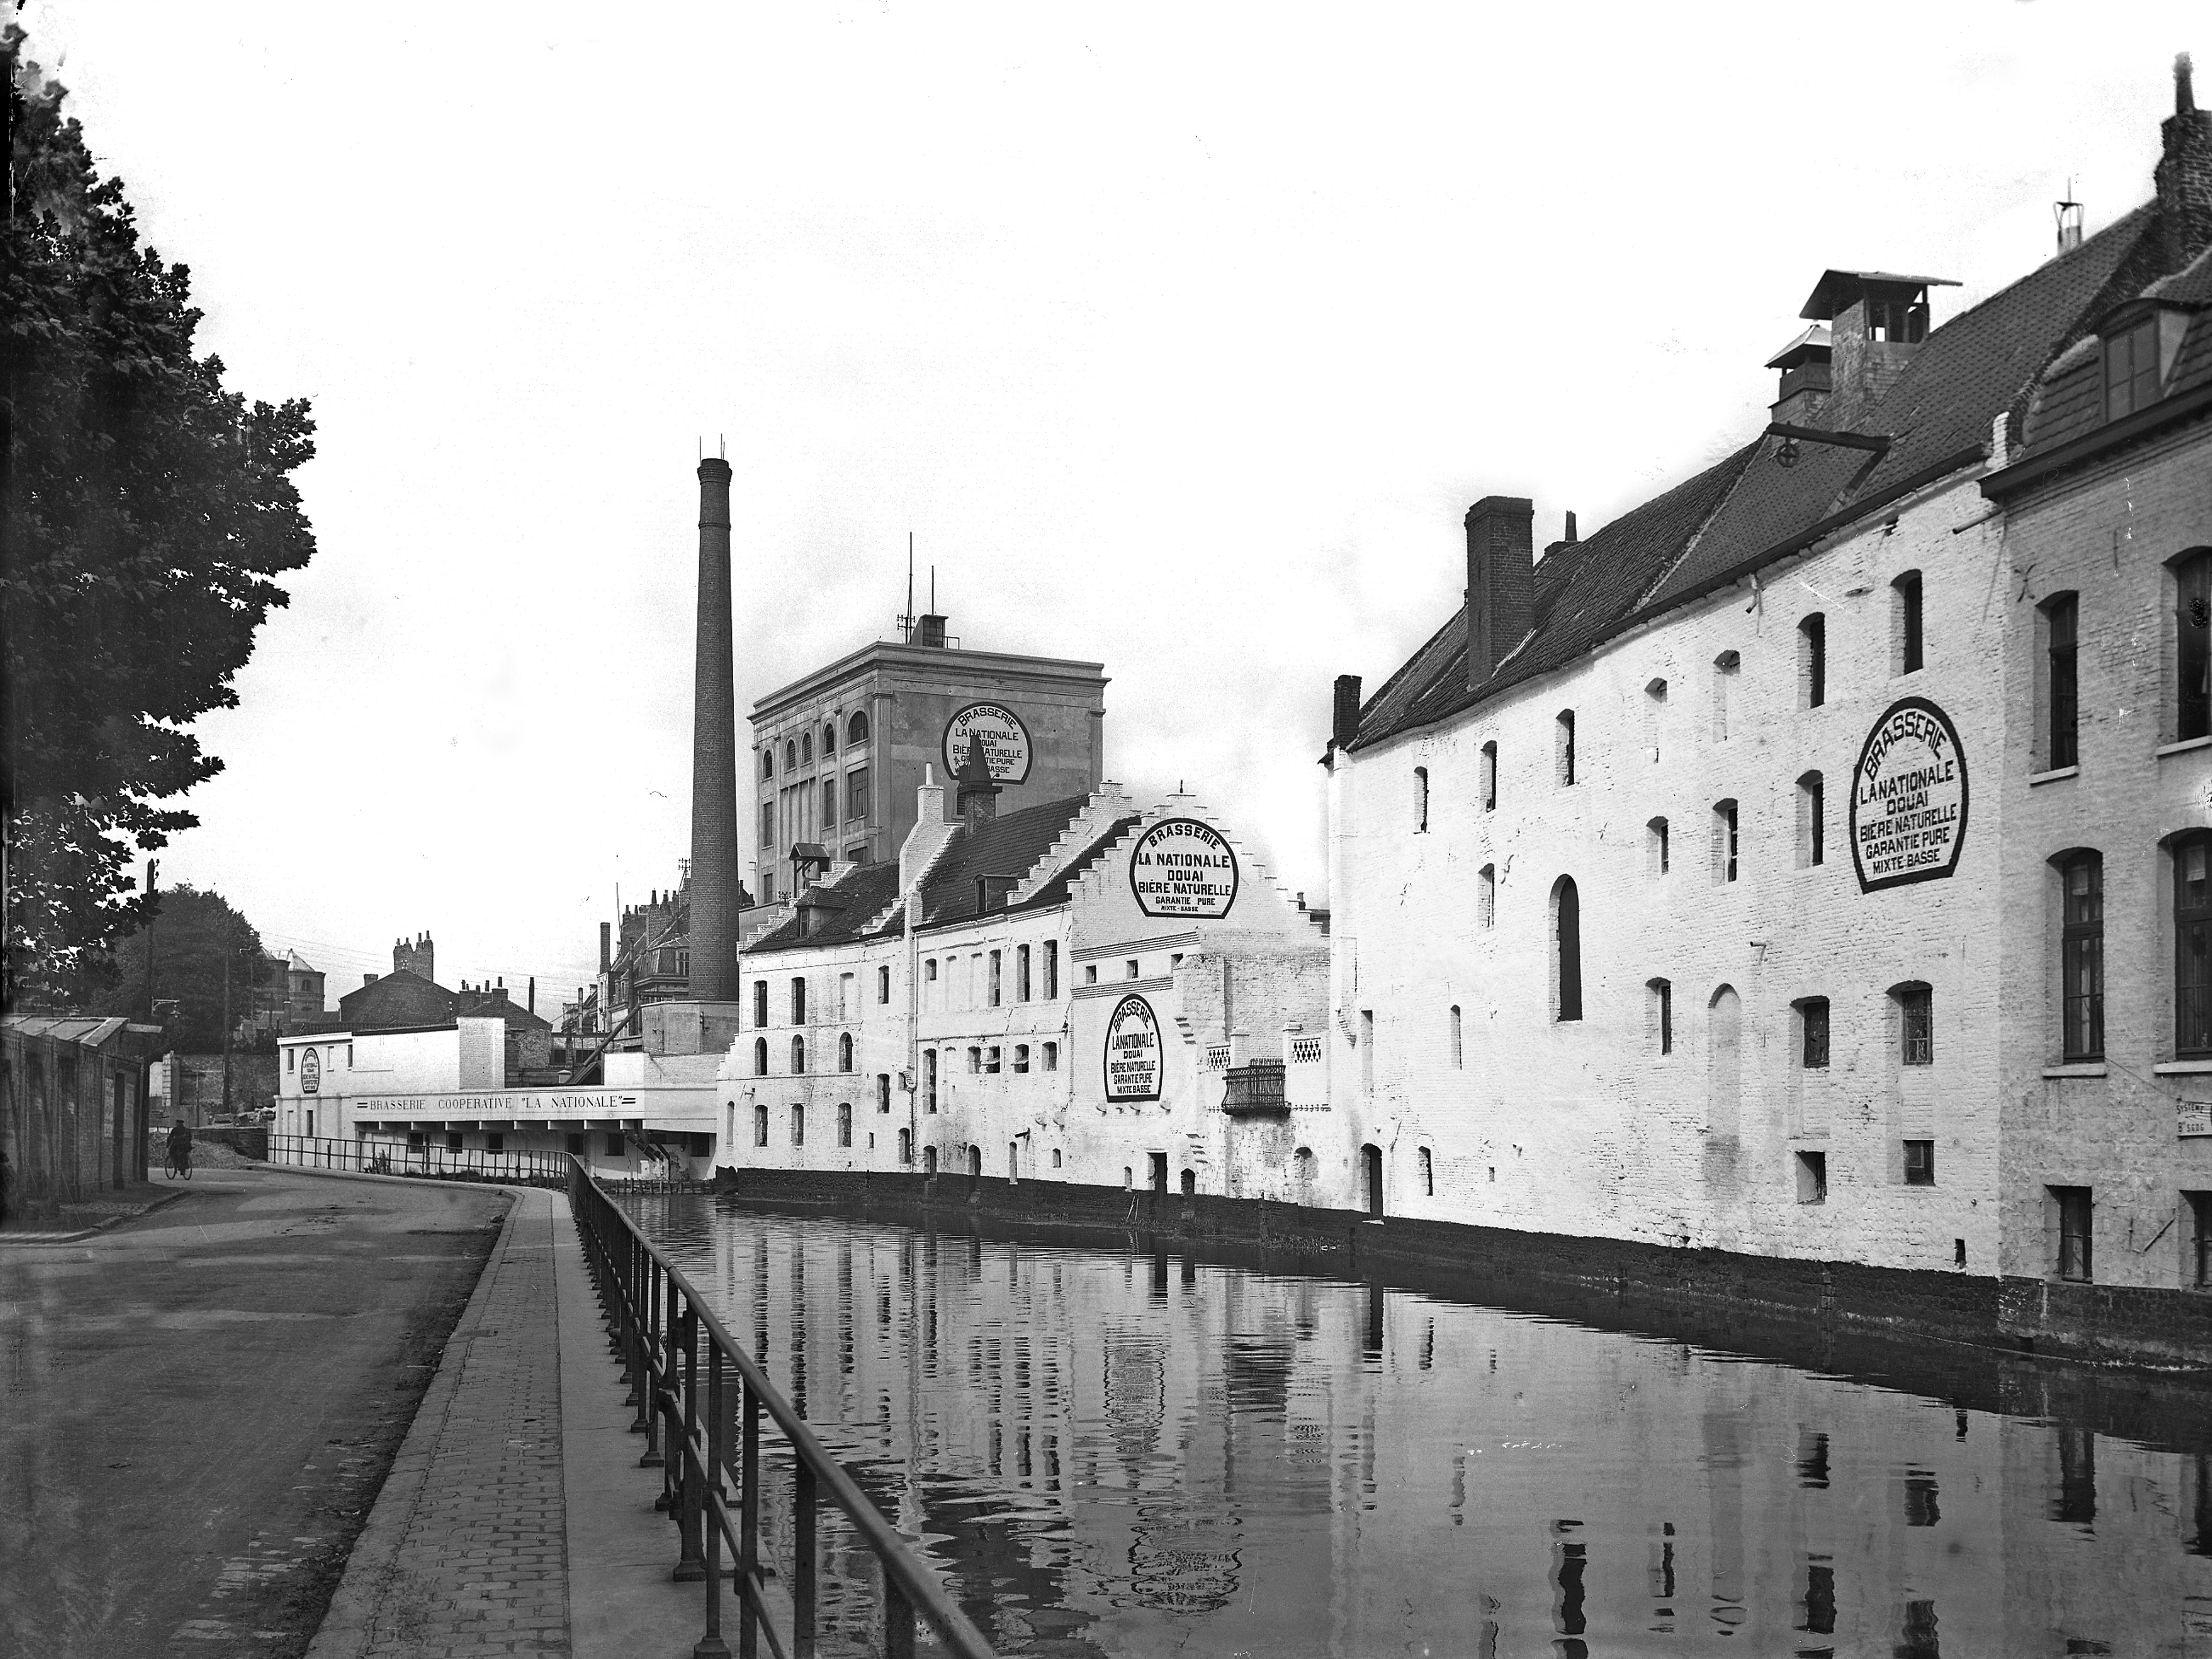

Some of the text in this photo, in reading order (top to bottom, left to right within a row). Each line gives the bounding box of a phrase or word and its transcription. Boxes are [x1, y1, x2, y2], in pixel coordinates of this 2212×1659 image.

[958, 708, 1016, 730] BRASSERIE
[956, 728, 1019, 741] LA NATIONALE
[984, 748, 1022, 759] ATURELLE
[1864, 712, 1947, 782] BRASSERIE
[1860, 759, 1954, 805] LA NATIONALE
[1887, 790, 1928, 815] DOUAI
[1860, 803, 1957, 842] BIÈRE NATURELLE
[1148, 824, 1221, 850] BRASSERIE
[1866, 826, 1950, 859] GARANTIE PURE
[1139, 853, 1230, 868] LA NATIONALE
[1167, 870, 1203, 882] DOUAI
[1138, 879, 1231, 896] BIÈRE NATURELLE
[1156, 896, 1216, 906] GARANTIE PURE
[1113, 1001, 1151, 1033] BRASSERIE
[1112, 1032, 1154, 1050] LA NATIONALE
[1123, 1049, 1143, 1059] DOUAI
[1127, 1060, 1156, 1073] NATURELLE
[1117, 1084, 1151, 1094] MIXTE BASSE
[370, 1099, 426, 1110] BRASSERIE
[438, 1097, 512, 1109] COOPERATIVE
